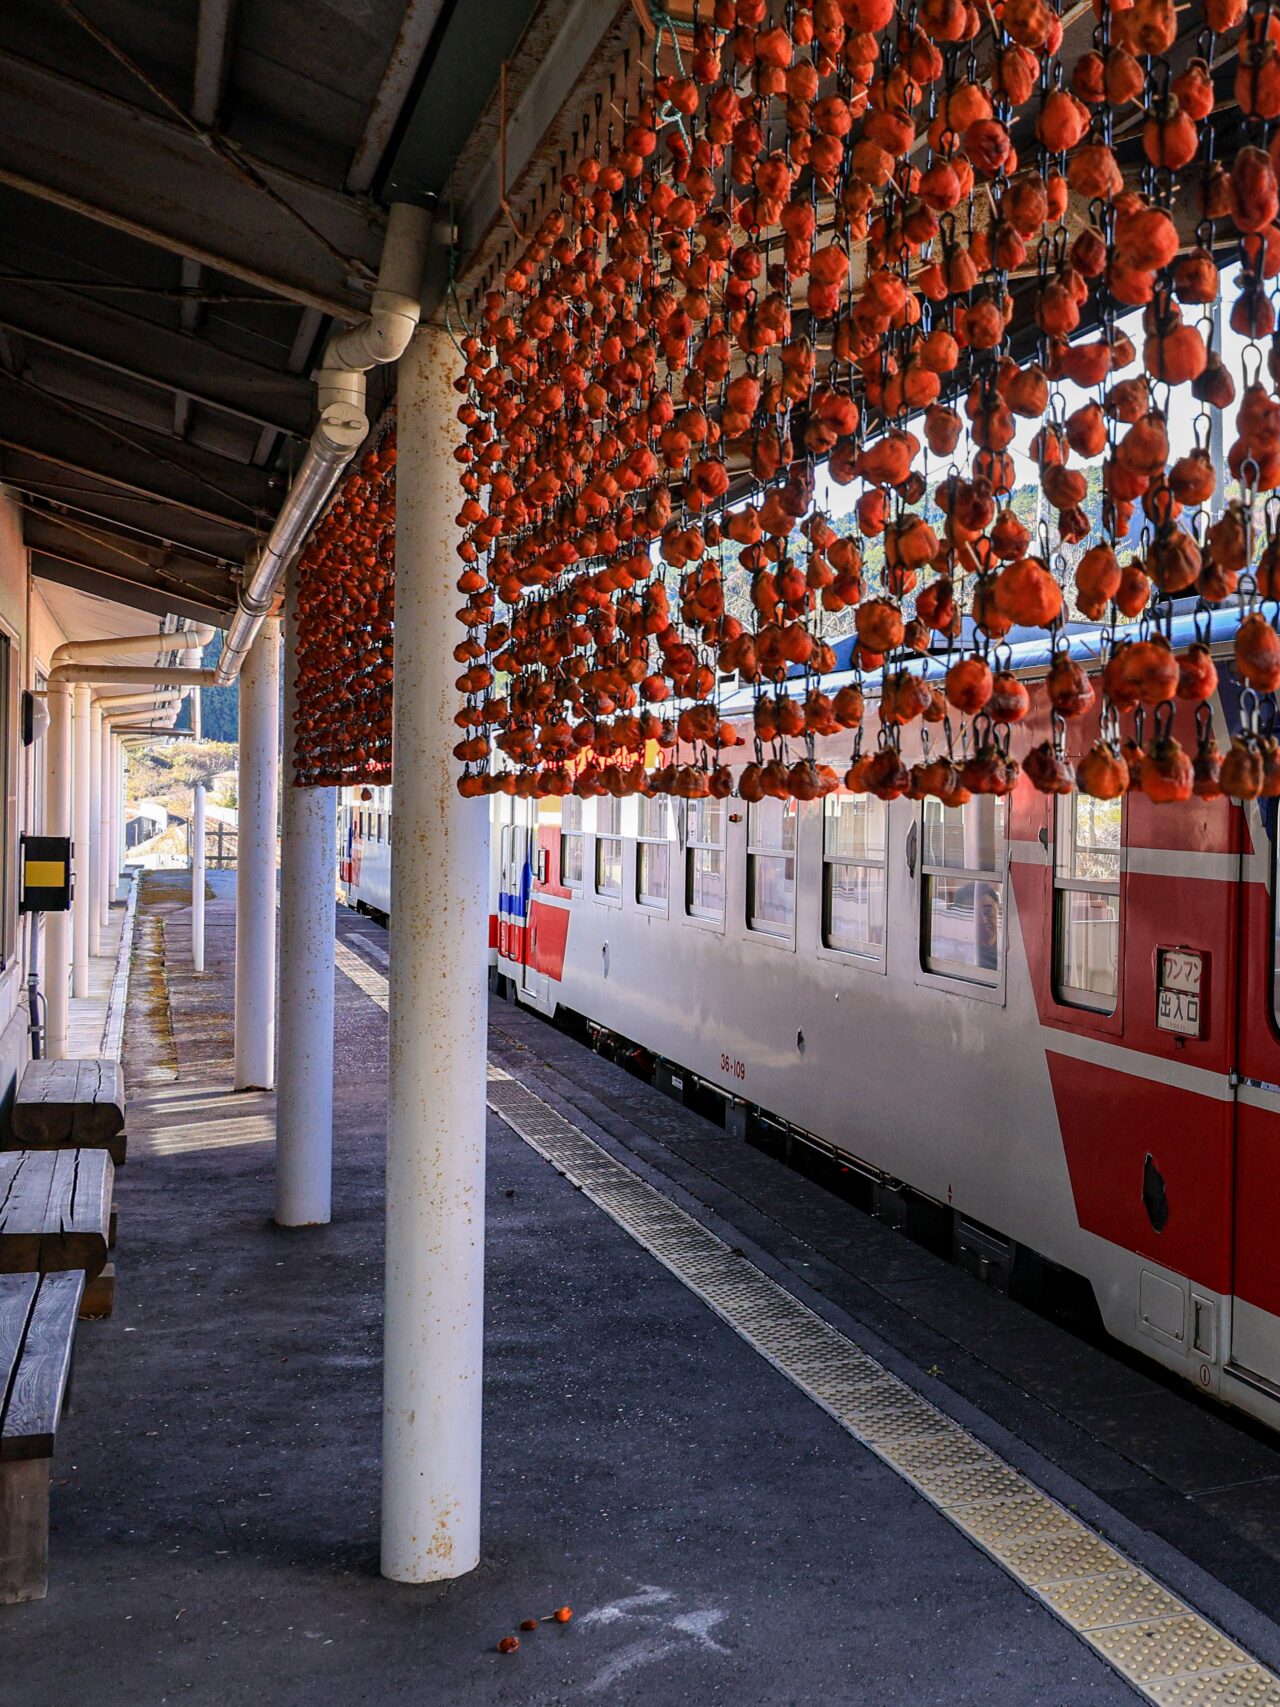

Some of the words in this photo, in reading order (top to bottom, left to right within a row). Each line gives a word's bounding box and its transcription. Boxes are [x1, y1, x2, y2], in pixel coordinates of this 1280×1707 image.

[1163, 957, 1201, 984] ワンマン
[1159, 993, 1198, 1023] 出入口
[720, 1053, 746, 1080] 36-109
